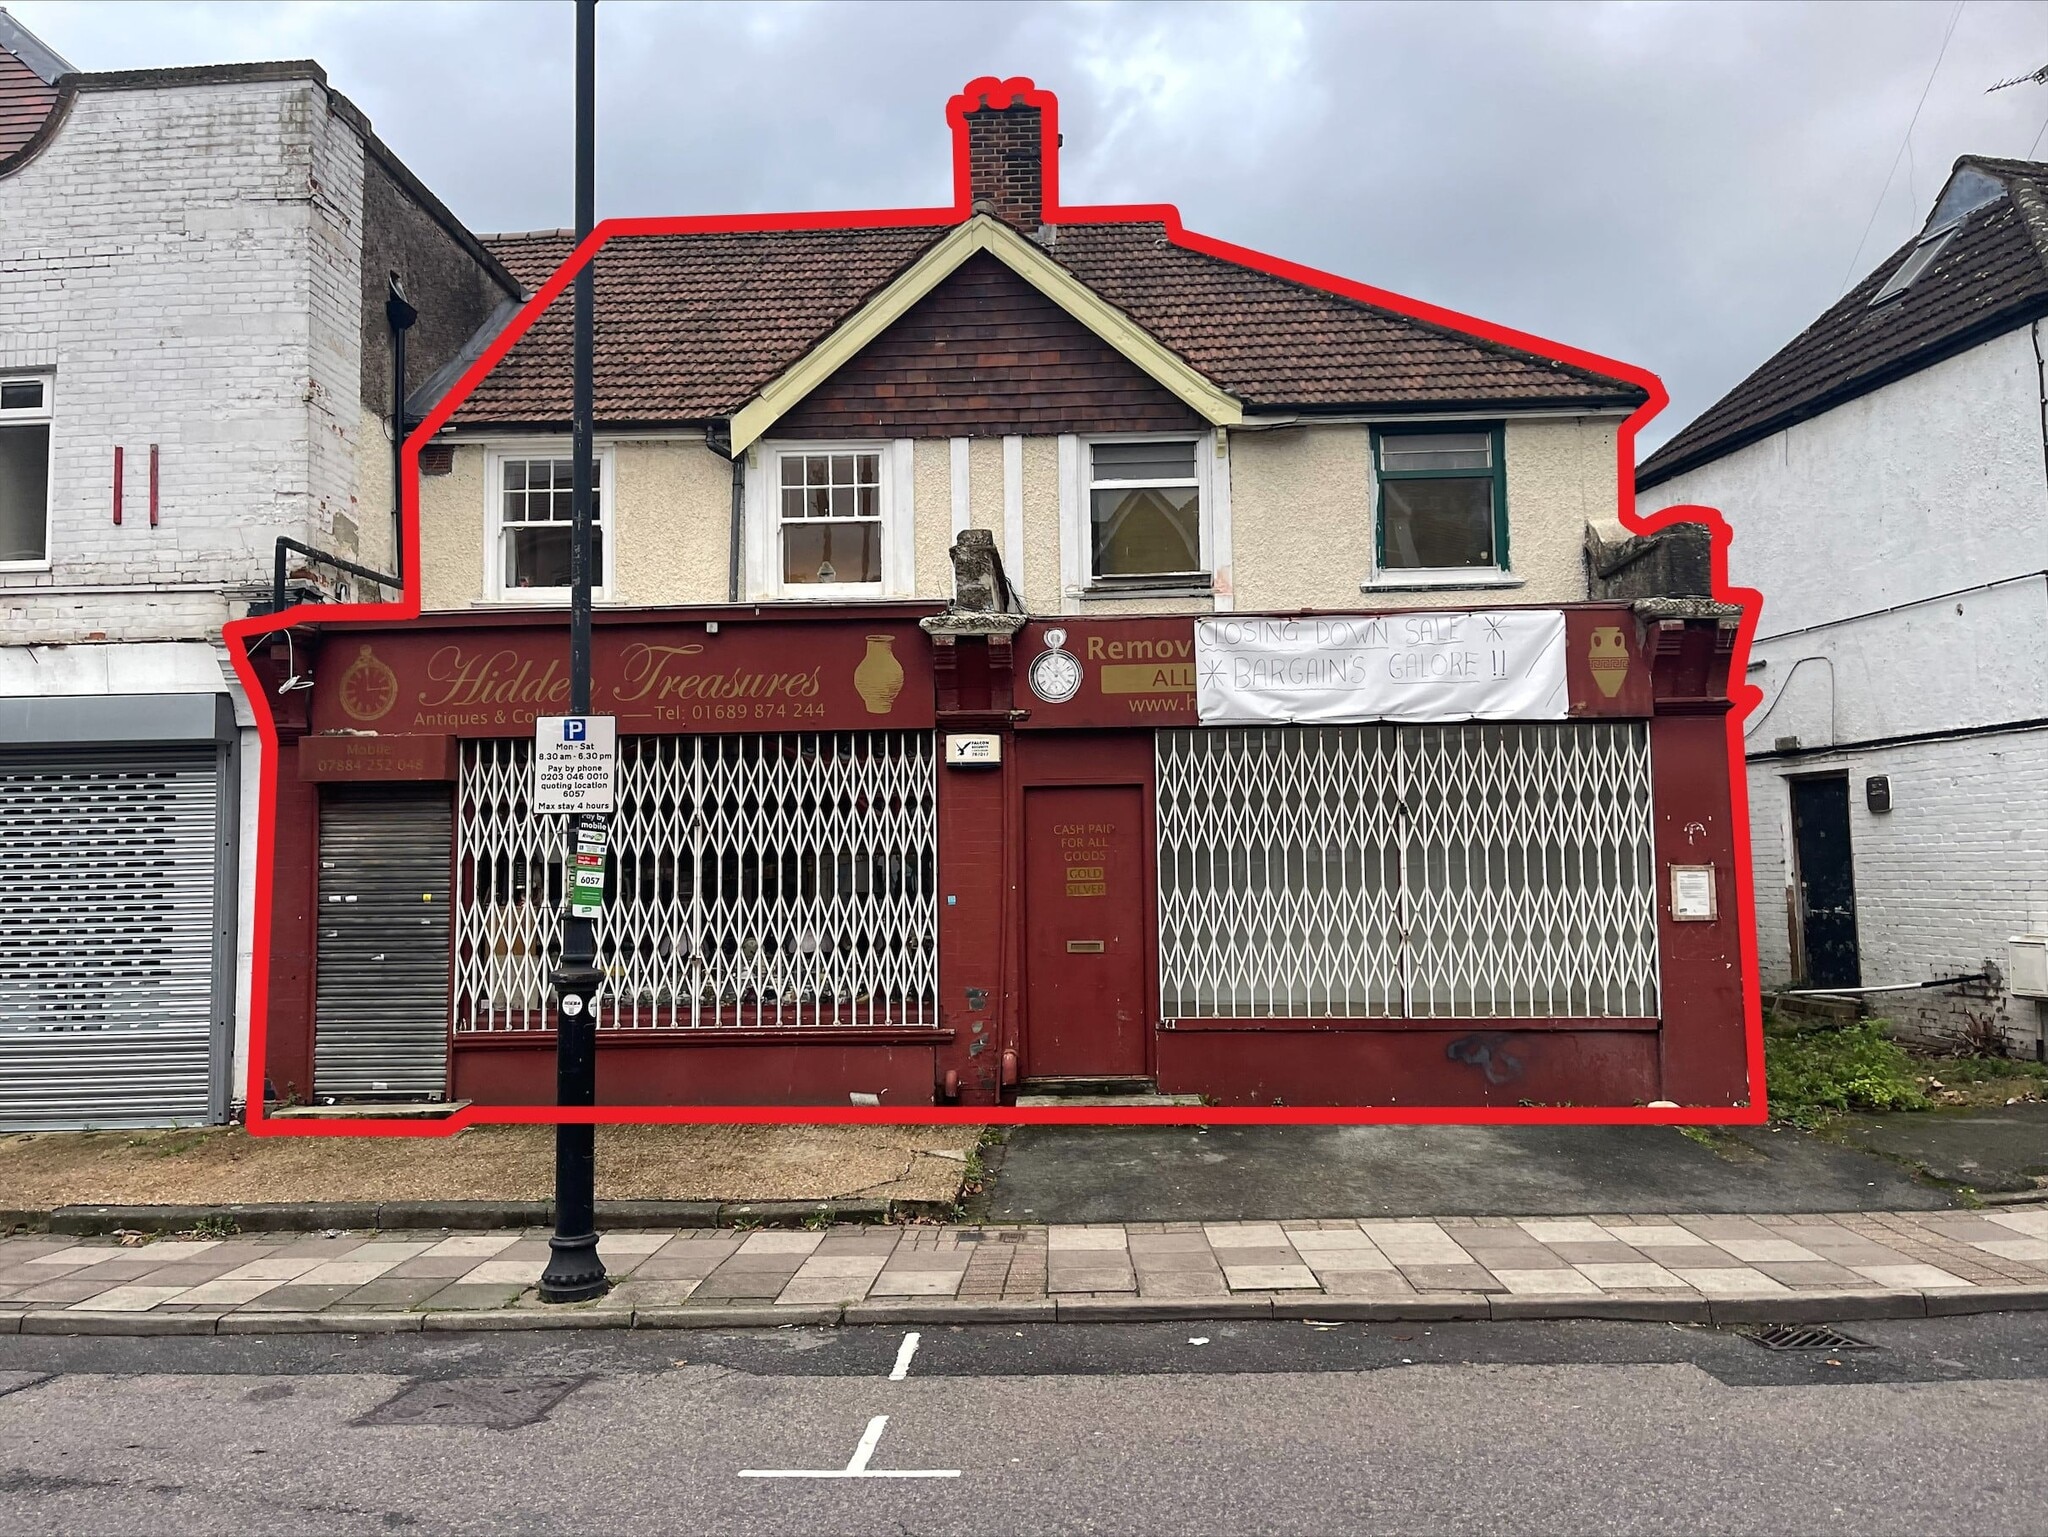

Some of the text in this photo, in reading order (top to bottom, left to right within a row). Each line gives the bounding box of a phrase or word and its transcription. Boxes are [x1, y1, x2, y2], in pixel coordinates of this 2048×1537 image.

[1198, 617, 1461, 647] CLOSING DOWN SALE
[1087, 636, 1192, 660] Remov
[1388, 651, 1480, 680] GALORE
[612, 642, 822, 701] Treasures
[1152, 669, 1196, 687] ALL
[413, 711, 488, 728] Antiques
[494, 709, 506, 724] &
[654, 705, 686, 720] Tel:
[692, 704, 747, 719] 01689
[754, 704, 786, 718] 874
[793, 703, 825, 718] 244
[569, 721, 583, 739] P
[346, 743, 392, 756] Mobile
[578, 752, 598, 760] 6.30
[547, 764, 603, 773] Pay by phone
[586, 772, 609, 780] 0010
[540, 781, 608, 790] quoting location
[538, 802, 555, 810] Max
[557, 802, 575, 810] stay
[596, 813, 606, 823] by
[581, 821, 607, 830] mobile
[1053, 824, 1085, 835] CASH
[1061, 837, 1109, 848] FOR ALL
[1064, 850, 1106, 861] GOODS
[1069, 868, 1102, 879] GOLD
[580, 876, 600, 885] 6057
[1067, 884, 1104, 894] SILVER
